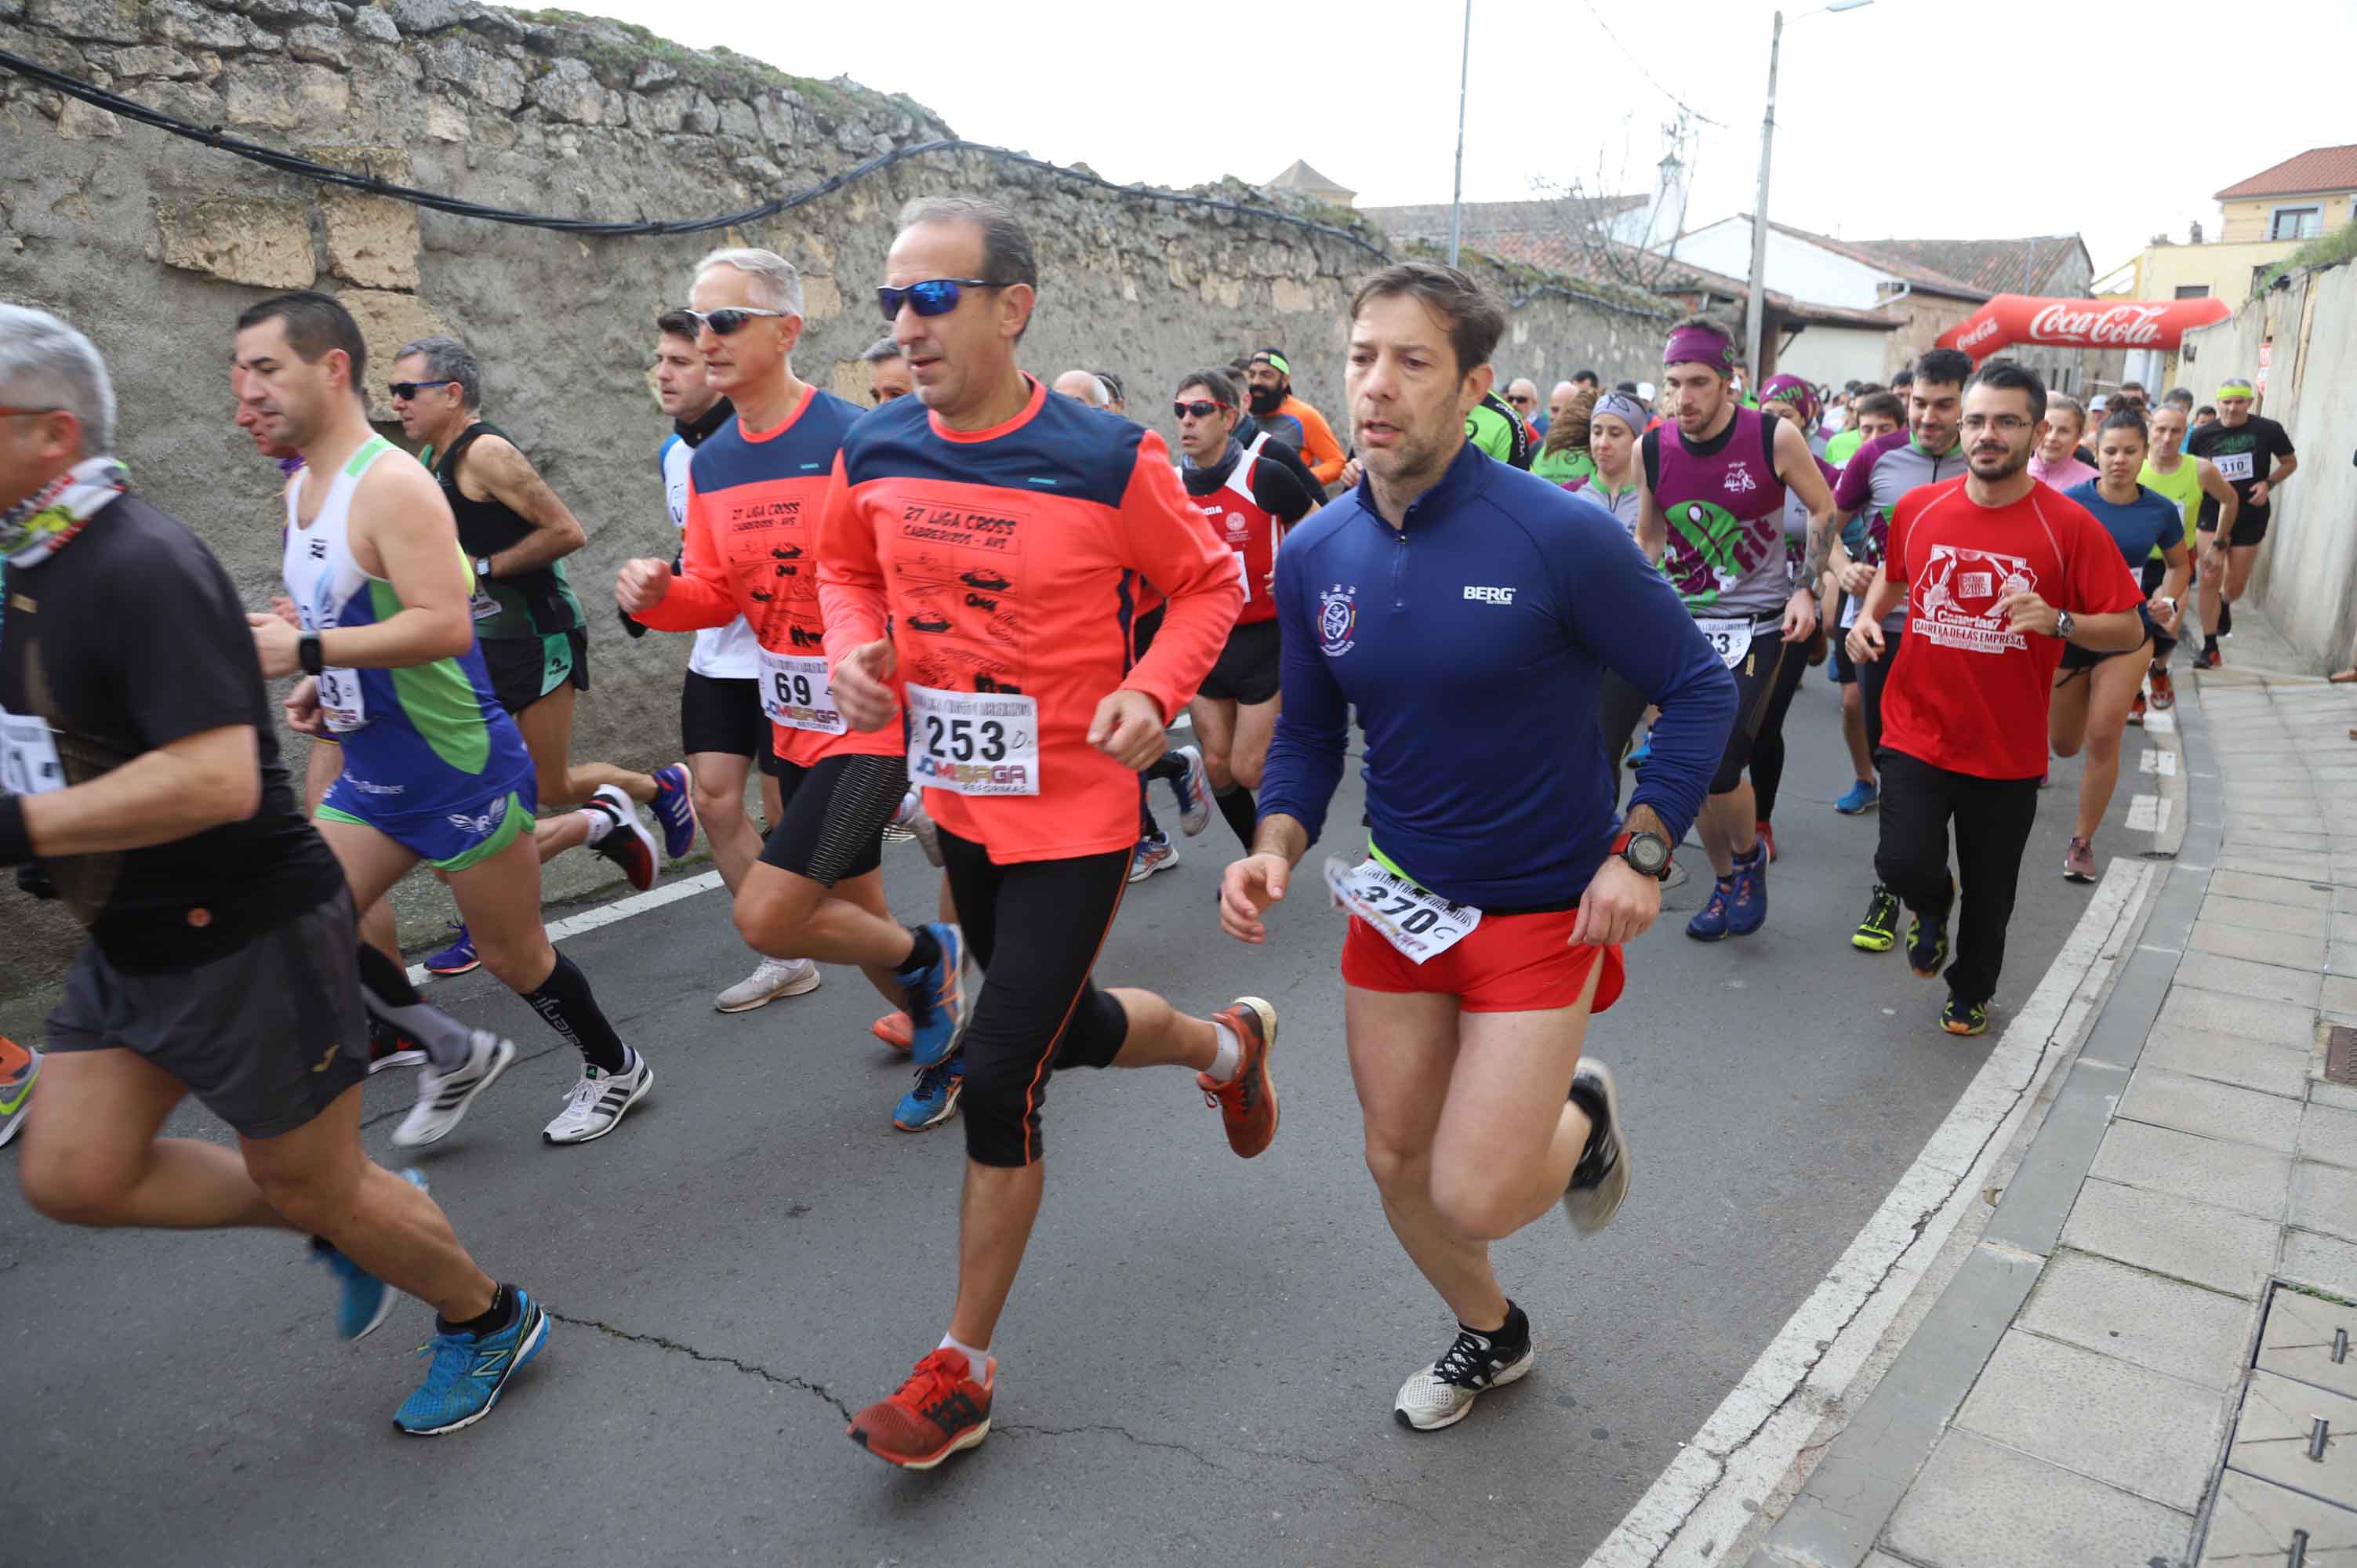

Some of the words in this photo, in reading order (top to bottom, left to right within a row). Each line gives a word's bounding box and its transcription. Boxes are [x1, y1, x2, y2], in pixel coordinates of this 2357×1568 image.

[2221, 460, 2244, 474] 310
[928, 510, 961, 528] LIGA
[965, 514, 1017, 535] CROSS
[1464, 586, 1513, 601] BERG
[775, 672, 812, 706] 69
[927, 716, 1006, 762] 253
[1354, 885, 1440, 935] 370
